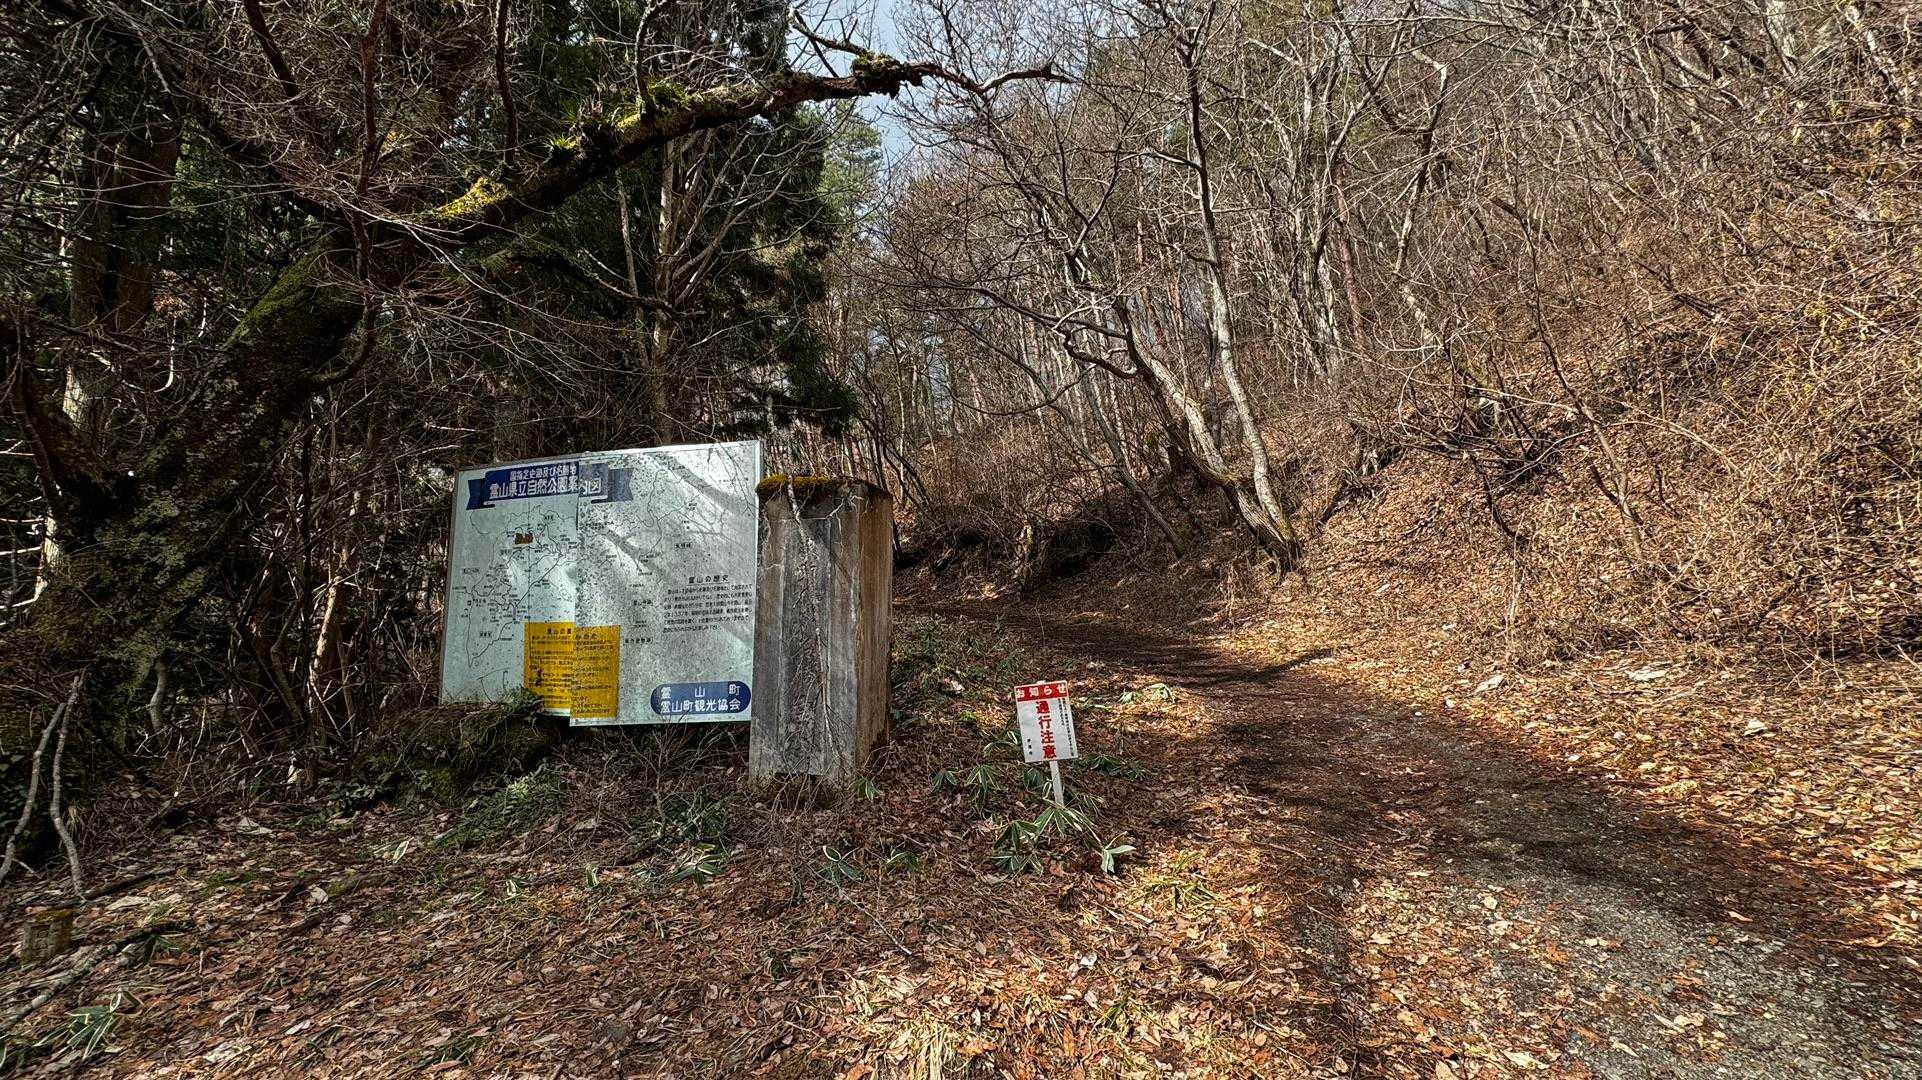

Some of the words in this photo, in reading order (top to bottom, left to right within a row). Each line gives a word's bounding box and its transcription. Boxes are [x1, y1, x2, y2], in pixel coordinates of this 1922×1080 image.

[1016, 684, 1066, 698] お知らせ
[660, 699, 741, 714] 霊山町観光協会
[1036, 700, 1057, 759] 通行注意
